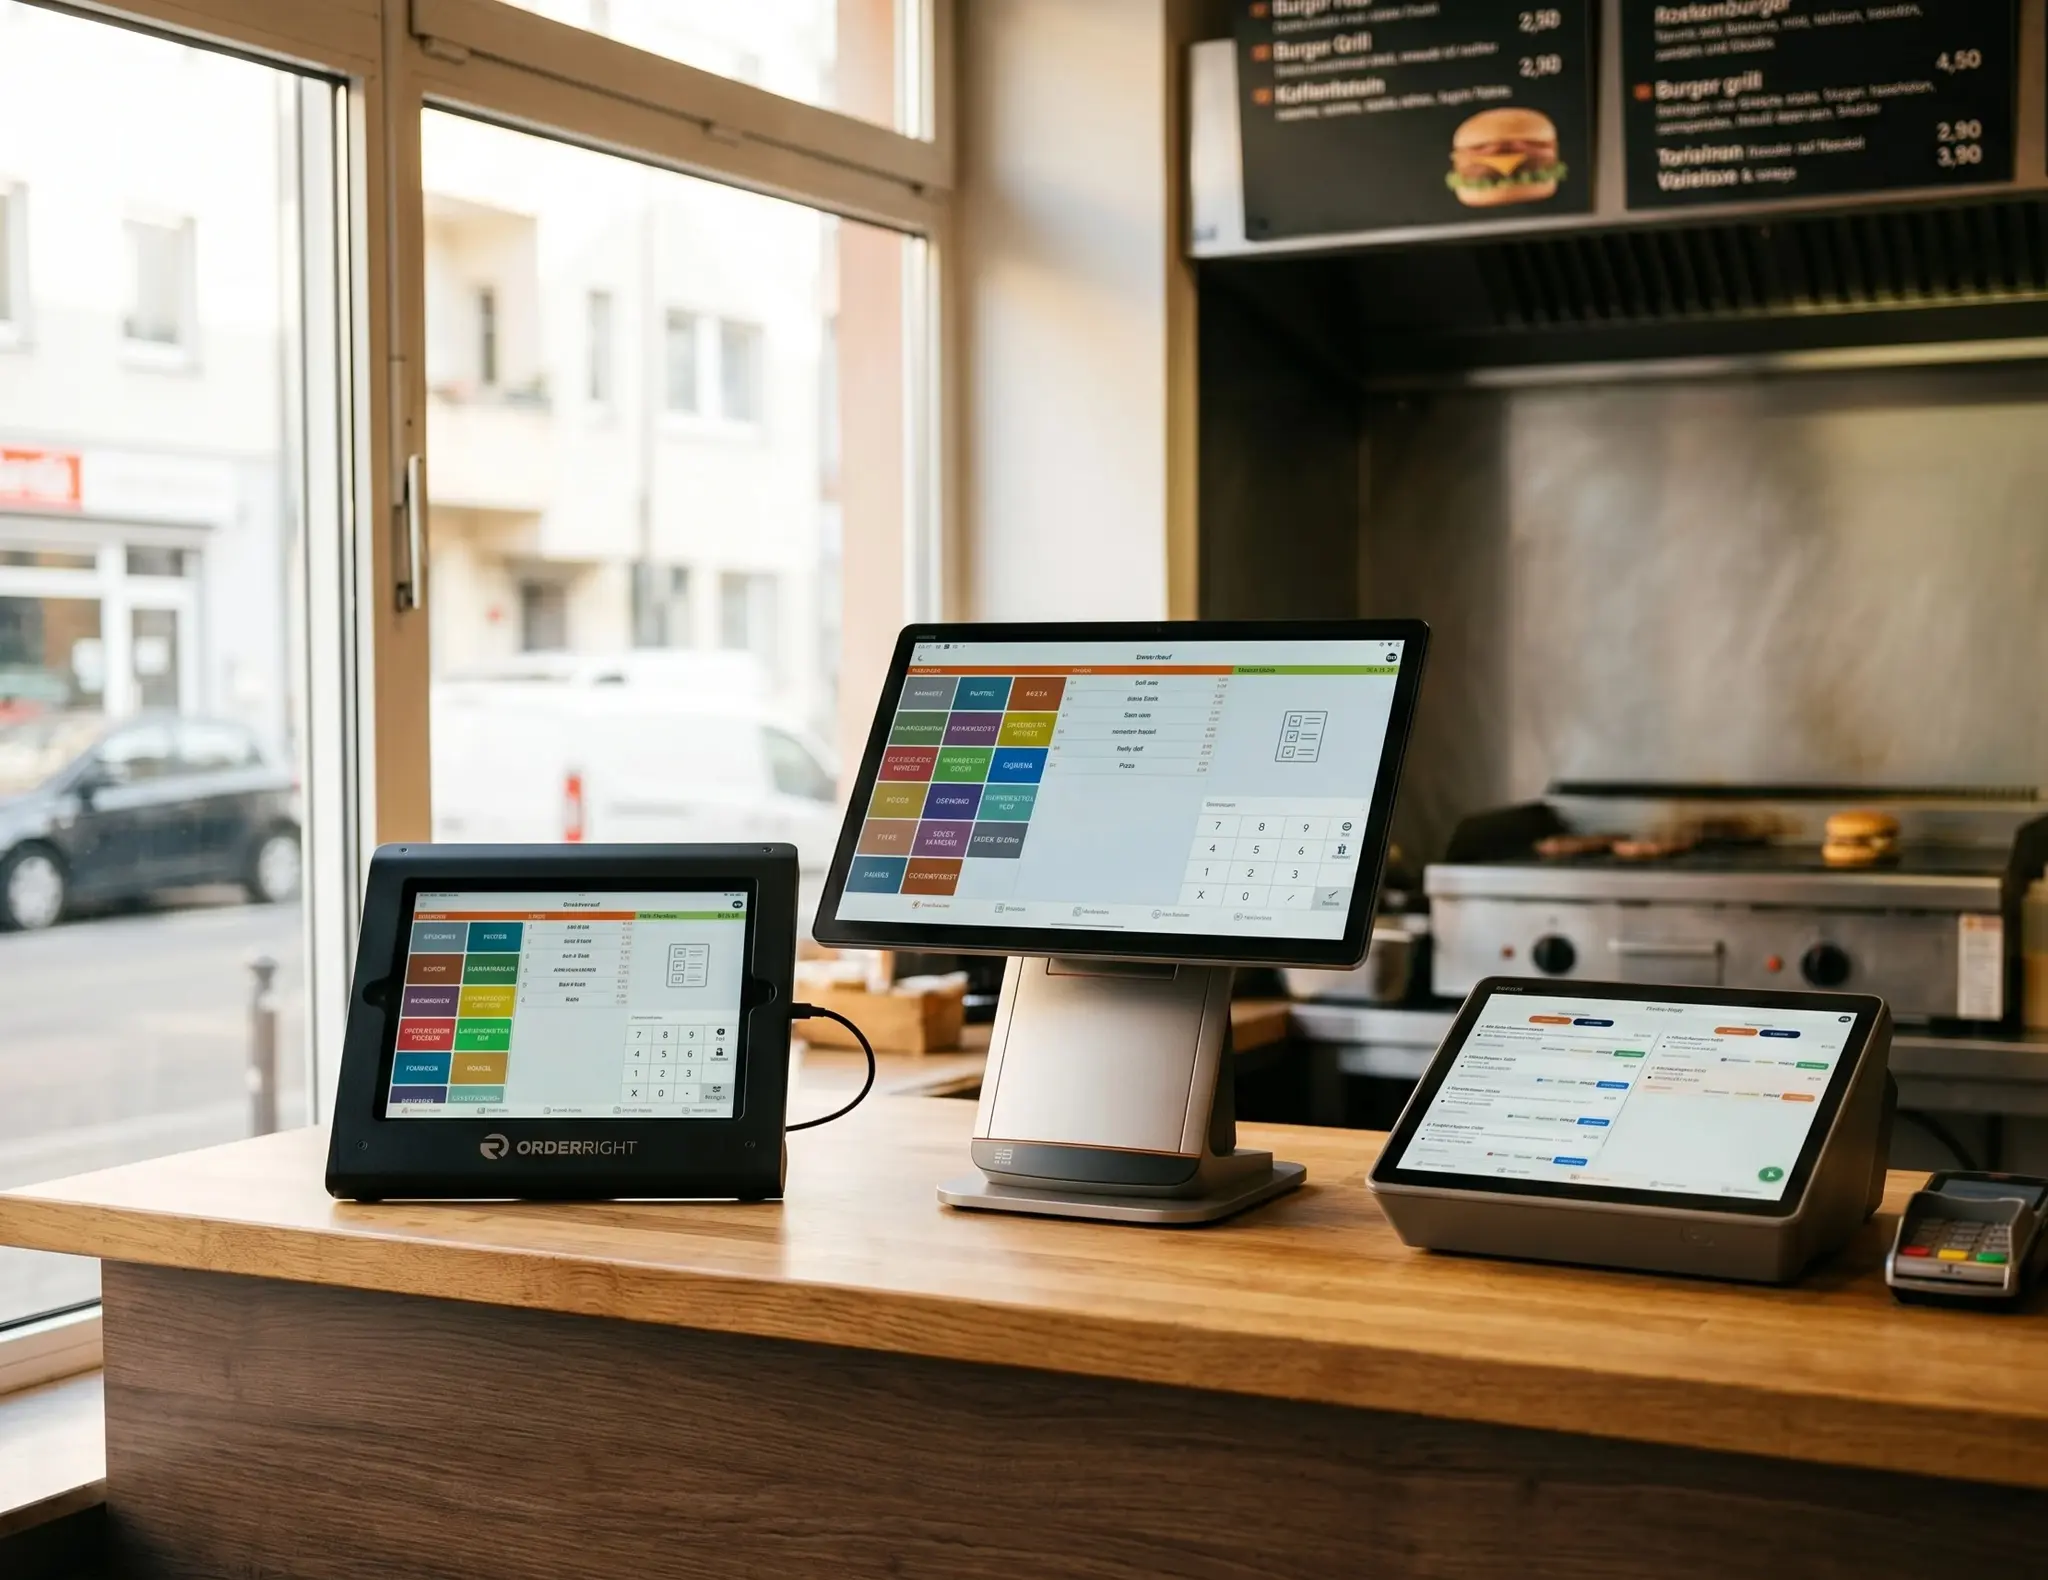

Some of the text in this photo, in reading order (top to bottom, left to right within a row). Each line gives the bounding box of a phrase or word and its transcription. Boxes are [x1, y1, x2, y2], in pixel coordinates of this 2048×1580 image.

[1273, 40, 1332, 62] Burger
[1936, 48, 1982, 74] 4,50
[1655, 79, 1721, 100] Burger
[1723, 70, 1762, 98] grill
[1215, 821, 1310, 833] 7 8 9
[1209, 844, 1305, 856] 4 5 6
[1247, 868, 1254, 878] 2
[1291, 869, 1299, 879] 3
[1242, 891, 1250, 901] 0
[516, 1140, 638, 1155] ORDERRIGHT
